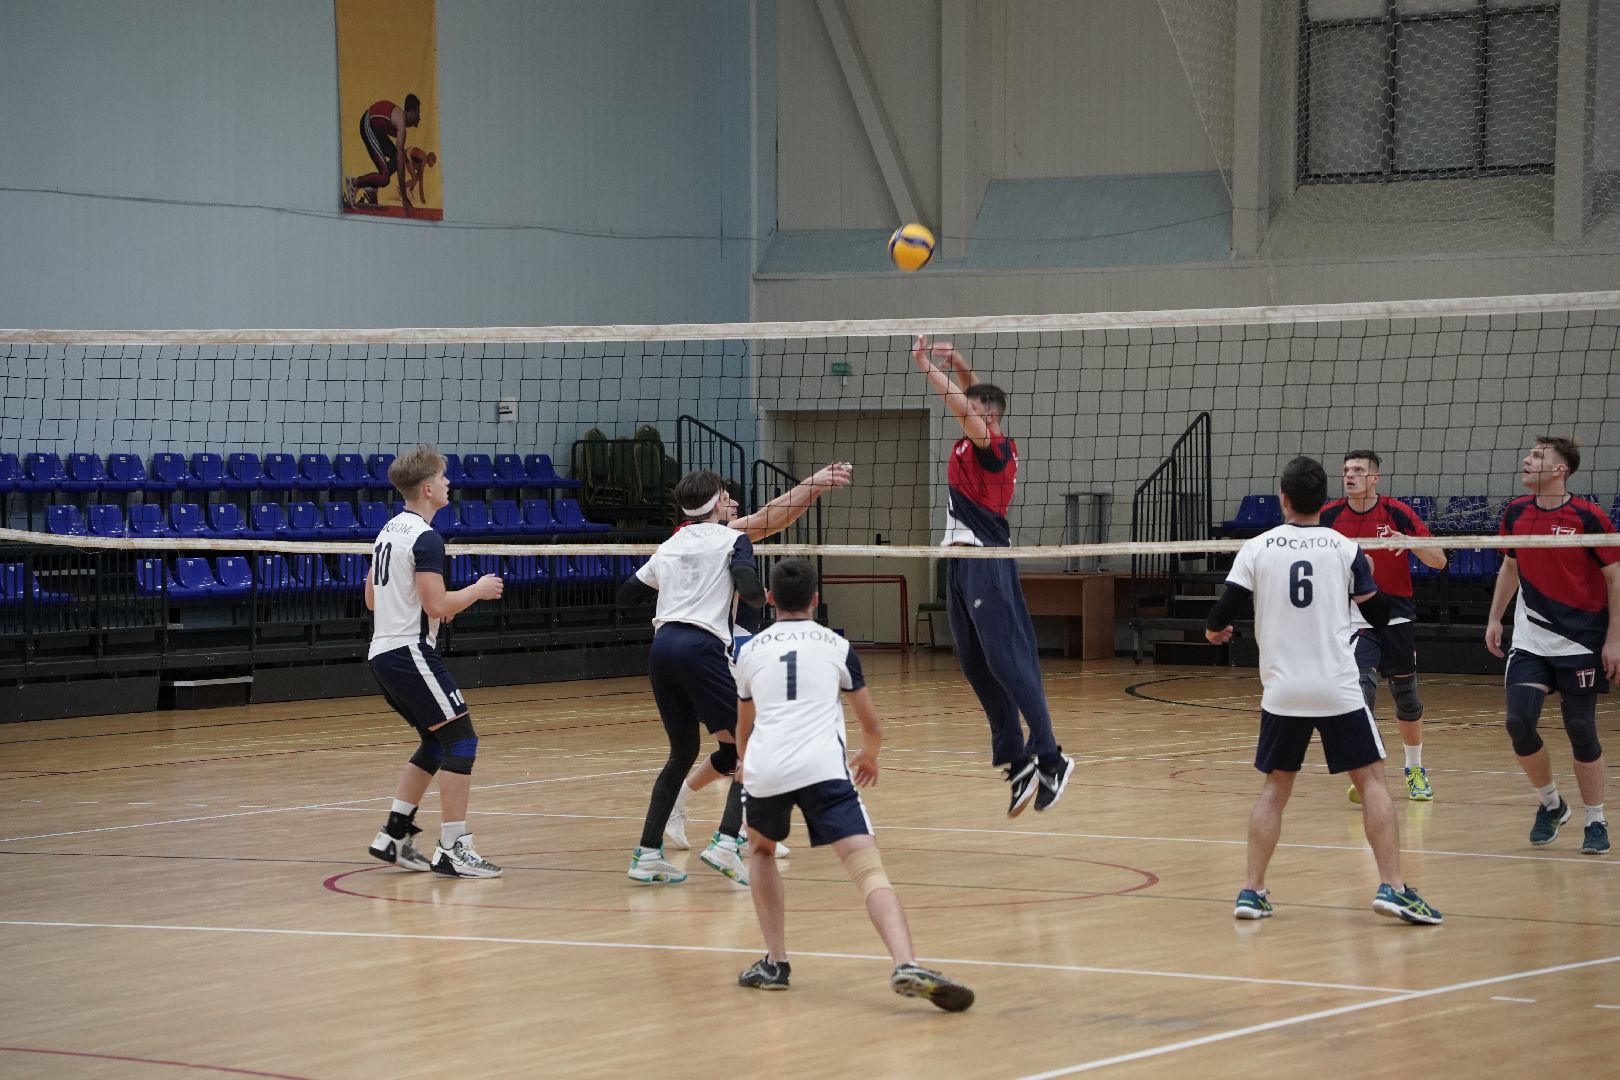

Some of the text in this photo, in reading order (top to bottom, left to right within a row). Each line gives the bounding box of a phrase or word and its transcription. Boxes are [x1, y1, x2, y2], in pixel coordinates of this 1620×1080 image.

[1266, 537, 1341, 550] РОСАТОМ
[374, 541, 392, 586] 10
[1289, 560, 1313, 608] 6
[752, 630, 837, 650] РОСАТОМ
[779, 650, 797, 701] 1
[1576, 669, 1595, 687] 17
